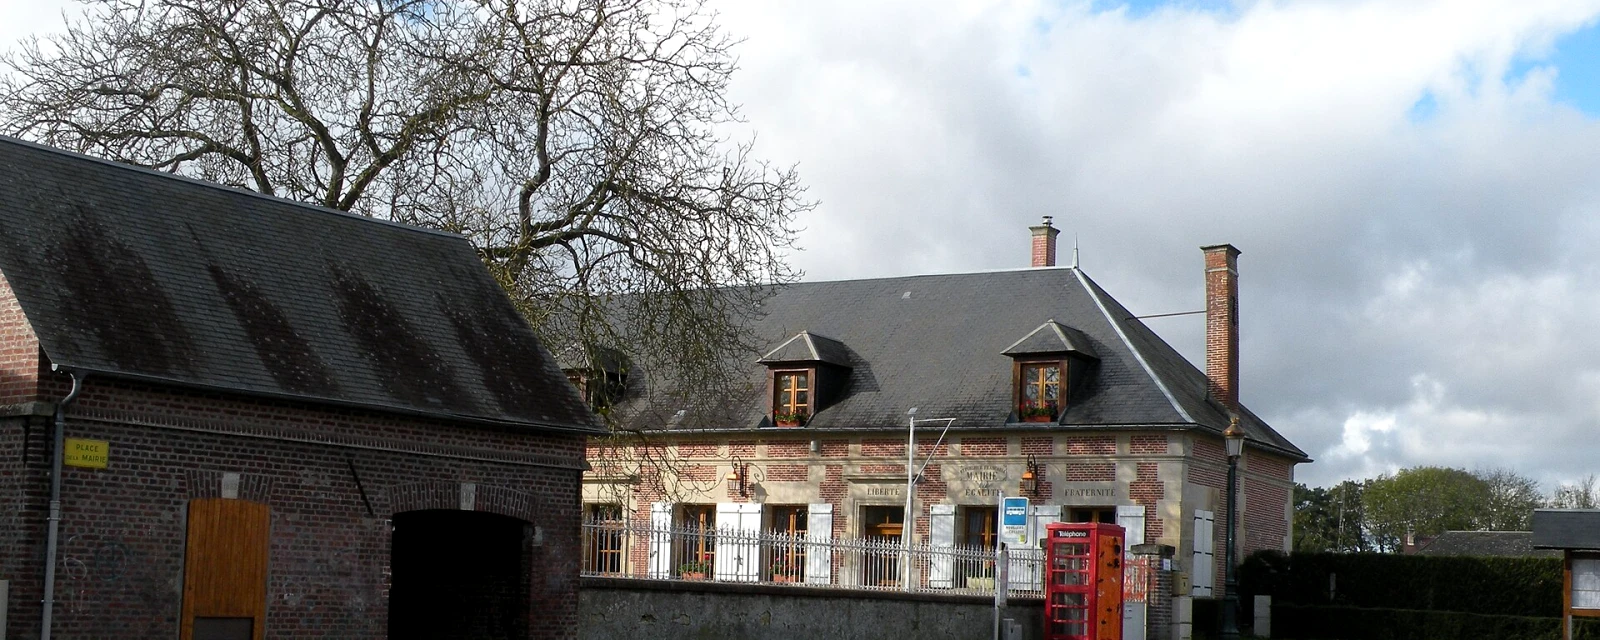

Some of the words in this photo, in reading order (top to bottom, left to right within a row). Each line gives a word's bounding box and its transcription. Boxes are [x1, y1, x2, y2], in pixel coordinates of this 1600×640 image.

[76, 443, 99, 452] PLACE
[82, 454, 106, 464] MAIRIE
[966, 471, 997, 480] MAIRIE
[867, 486, 900, 496] LIBERTÉ
[1064, 486, 1116, 496] FRATERNITÉ
